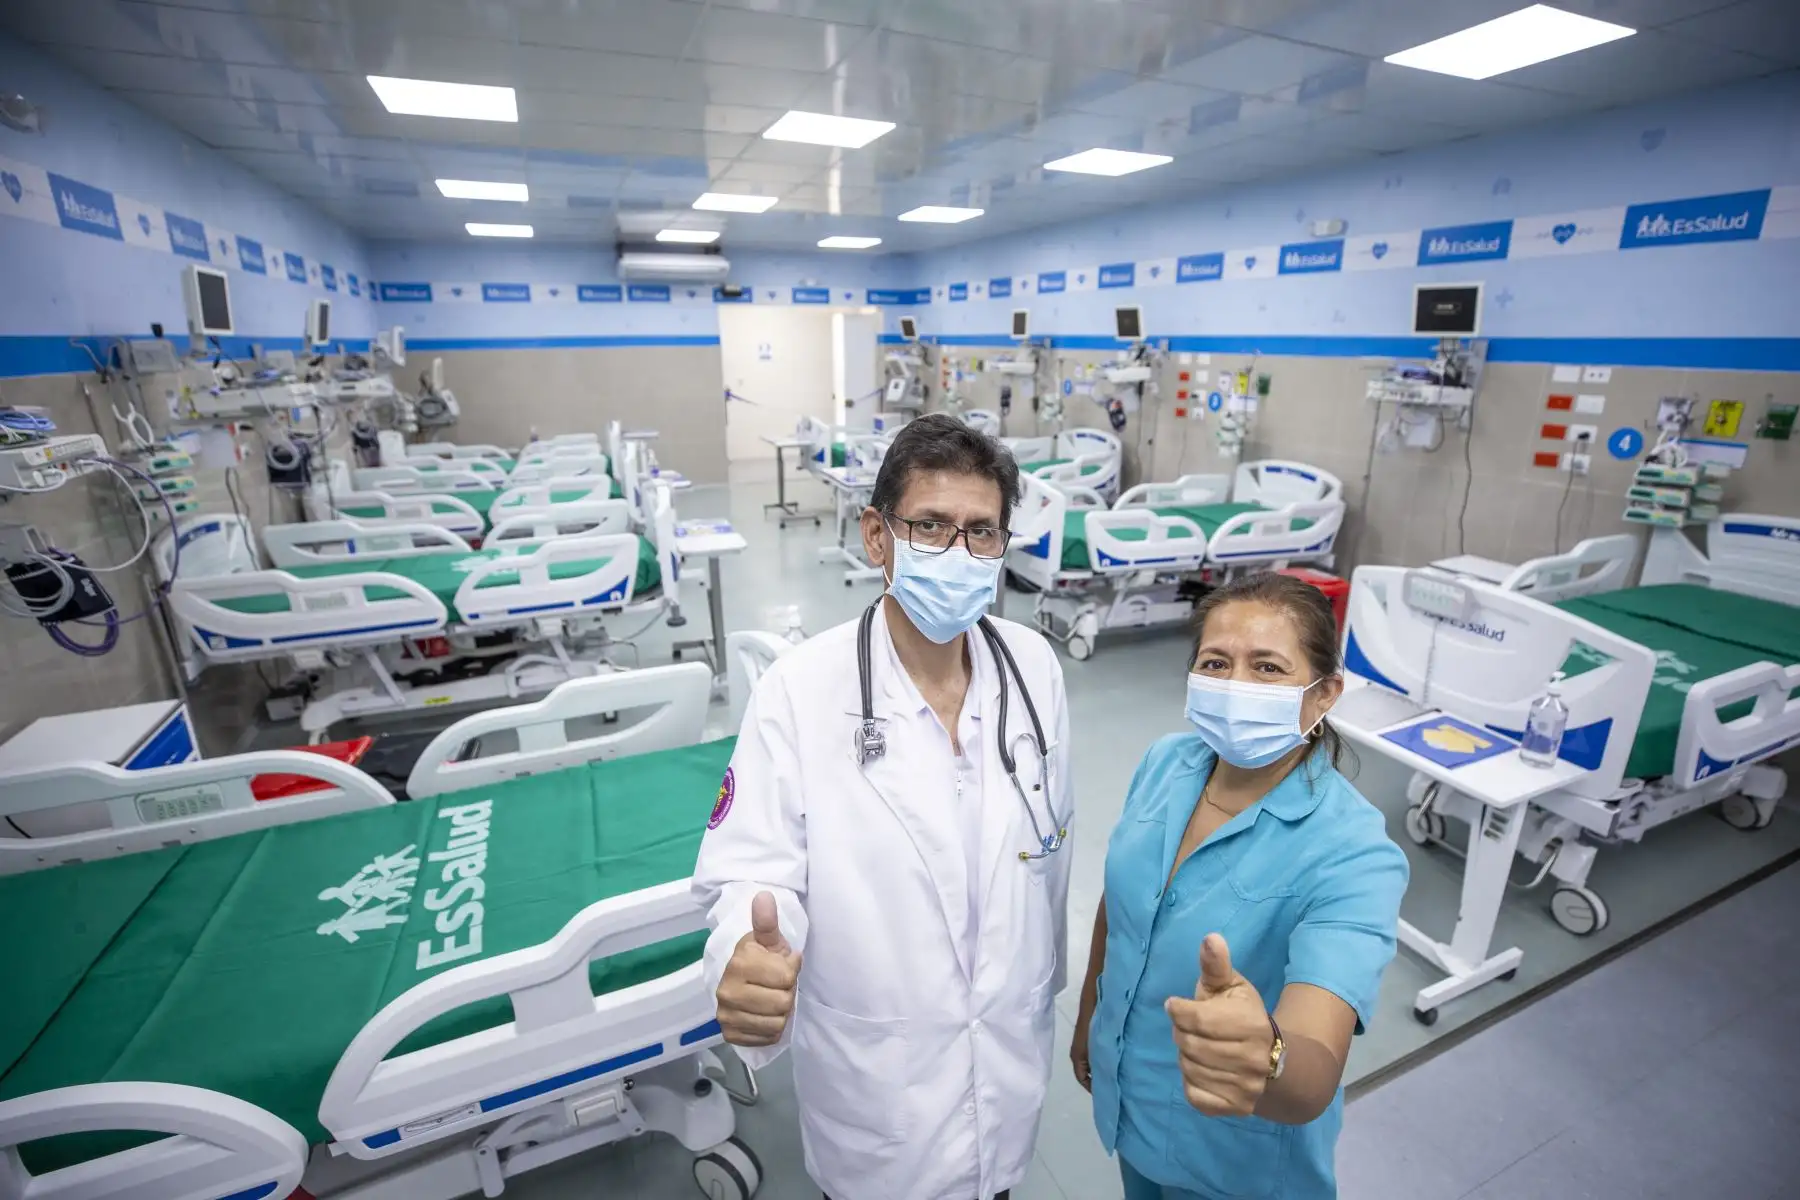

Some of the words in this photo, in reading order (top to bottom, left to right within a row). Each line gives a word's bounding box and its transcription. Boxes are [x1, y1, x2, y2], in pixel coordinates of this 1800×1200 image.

[1673, 211, 1749, 236] EsSalud
[1452, 236, 1500, 254] EsSalud
[1618, 434, 1632, 452] 4
[416, 799, 493, 971] EsSalud
